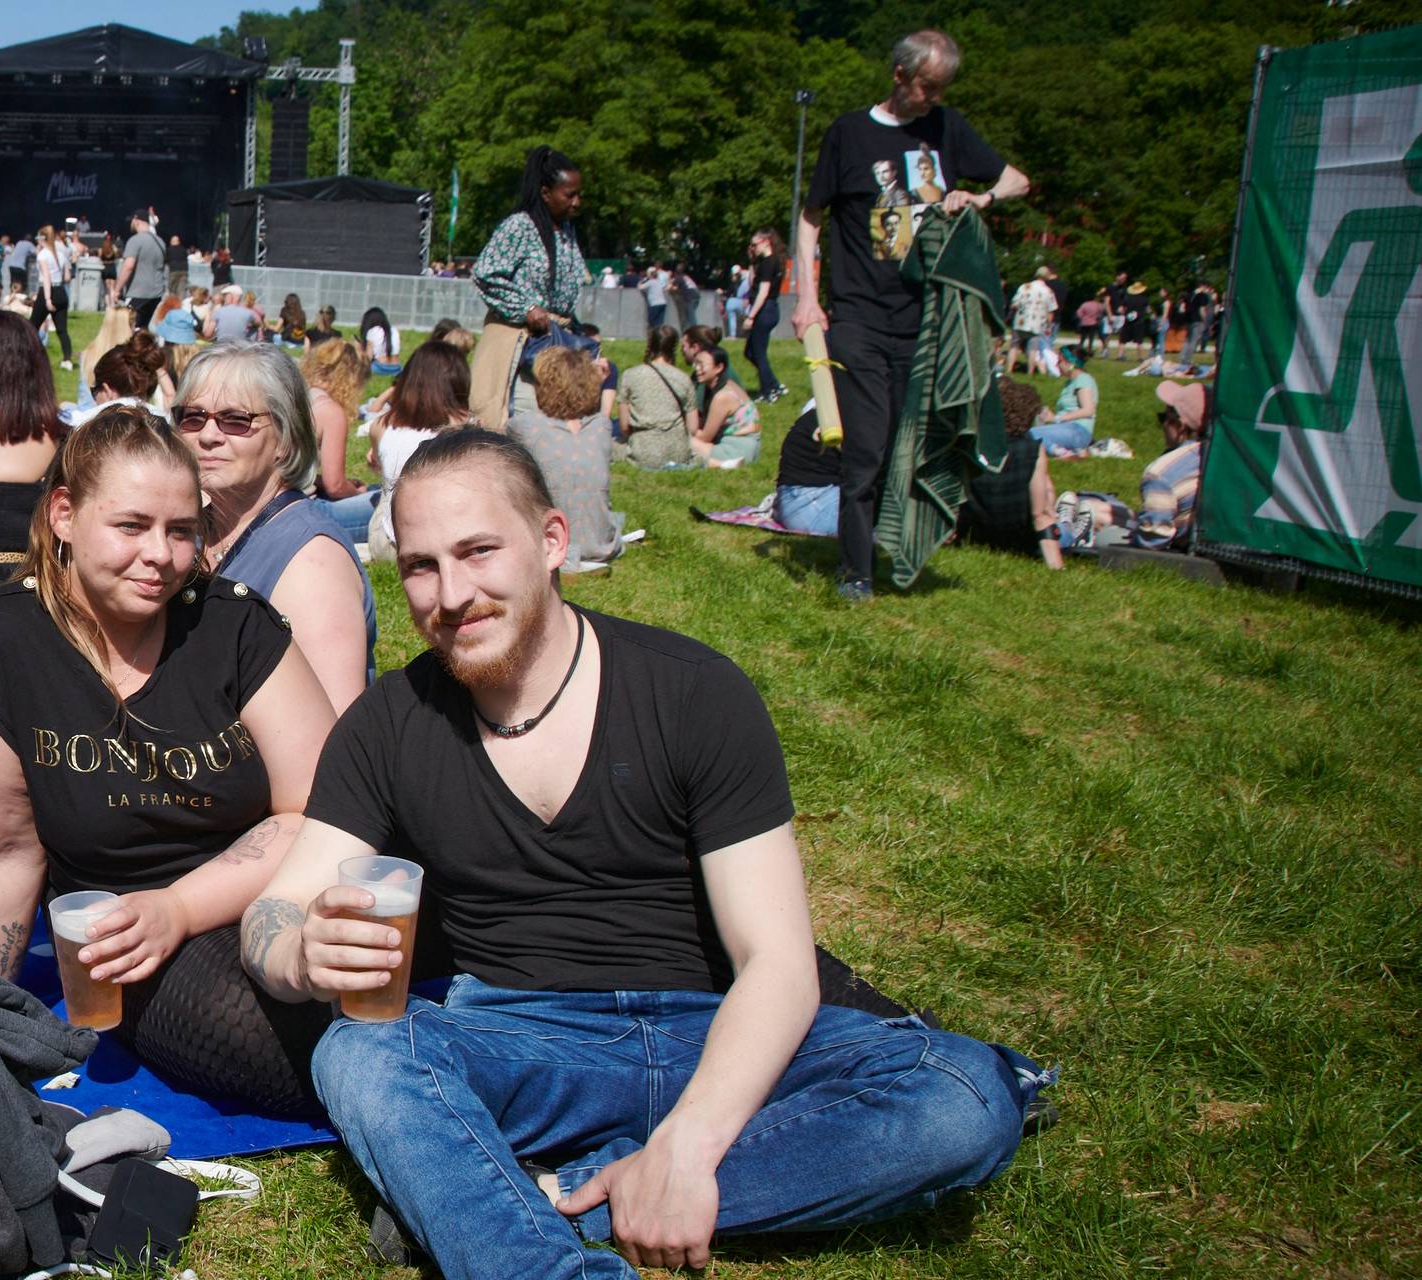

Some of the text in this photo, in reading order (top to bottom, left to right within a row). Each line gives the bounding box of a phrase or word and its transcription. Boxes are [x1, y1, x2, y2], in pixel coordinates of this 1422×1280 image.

[31, 720, 256, 783] BONJOUR
[107, 792, 213, 808] LA FRANCE
